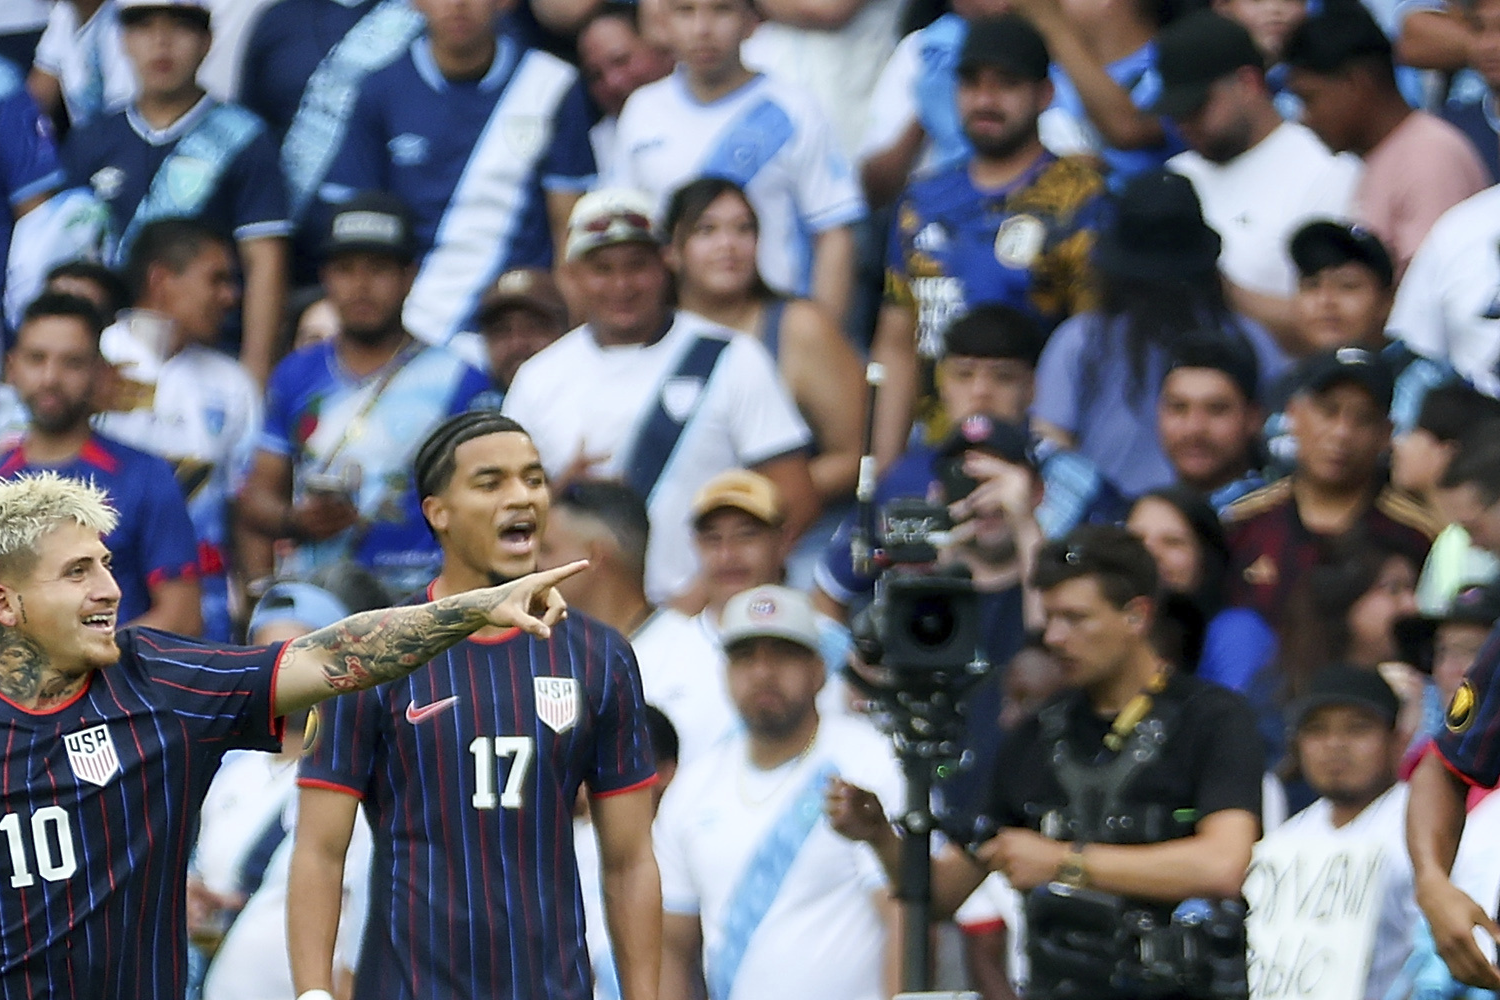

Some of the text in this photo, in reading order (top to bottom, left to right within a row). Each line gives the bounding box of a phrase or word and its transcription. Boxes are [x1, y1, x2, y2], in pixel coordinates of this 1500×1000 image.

[537, 681, 573, 700] USA
[68, 727, 108, 754] USA
[469, 736, 533, 809] 17
